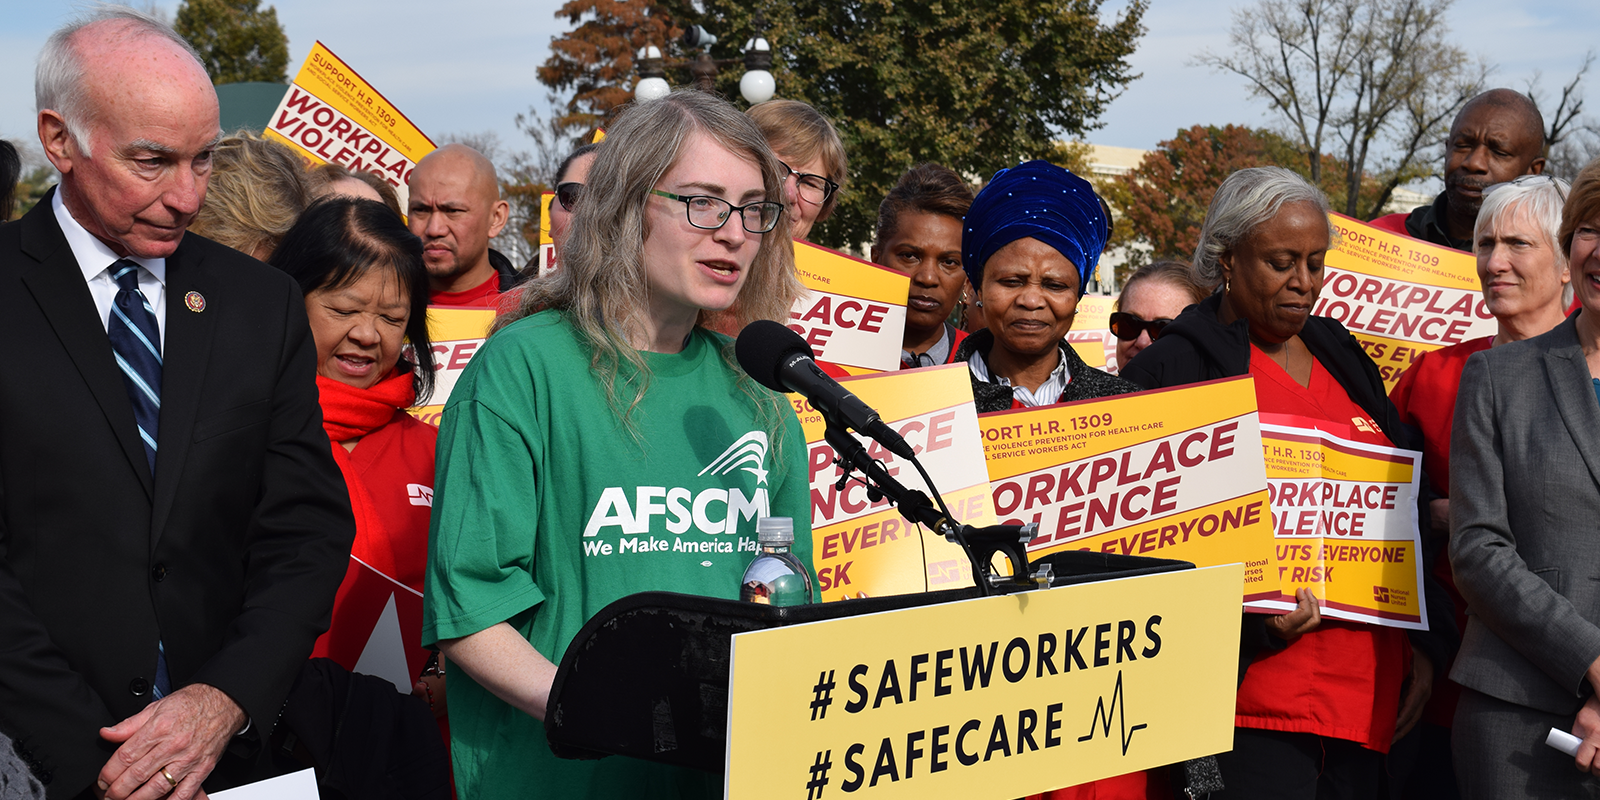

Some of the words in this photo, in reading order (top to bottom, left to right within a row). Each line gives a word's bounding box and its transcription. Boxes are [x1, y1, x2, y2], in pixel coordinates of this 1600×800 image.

[312, 53, 357, 92] SUPPORT
[356, 90, 373, 109] H.R.
[375, 105, 396, 127] 1309
[356, 100, 380, 123] PREVENTION
[1346, 249, 1370, 262] SERVICE
[1371, 258, 1400, 271] WORKERS
[1402, 267, 1414, 275] ACT
[1350, 243, 1378, 257] VIOLENCE
[1378, 253, 1416, 269] PREVENTION
[1418, 265, 1430, 273] FOR
[1432, 269, 1456, 279] HEALTH
[1457, 275, 1474, 284] CARE
[1378, 241, 1403, 257] H.R.
[1408, 250, 1439, 266] 1309
[812, 274, 831, 284] CARE
[1078, 304, 1104, 314] 1309
[1313, 297, 1472, 343] IOLENCE
[1030, 420, 1065, 436] H.R.
[1070, 413, 1112, 430] 1309
[992, 440, 1033, 451] VIOLENCE
[1035, 433, 1087, 445] PREVENTION
[1089, 430, 1106, 438] FOR
[1108, 425, 1139, 435] HEALTH
[1141, 422, 1164, 430] CARE
[992, 450, 1026, 460] SERVICE
[1028, 444, 1069, 455] WORKERS
[1071, 442, 1087, 450] ACT
[1273, 446, 1296, 459] H.R.
[1300, 450, 1326, 462] 1309
[1276, 458, 1310, 467] PREVENTION
[992, 421, 1239, 516] ORKPLACE
[583, 540, 612, 556] We
[619, 536, 668, 554] Make
[673, 536, 733, 553] America
[1317, 544, 1406, 563] EVERYONE
[1291, 567, 1334, 582] RISK
[1390, 588, 1409, 596] National
[810, 615, 1163, 721] #SAFEWORKERS
[806, 703, 1063, 800] #SAFECARE
